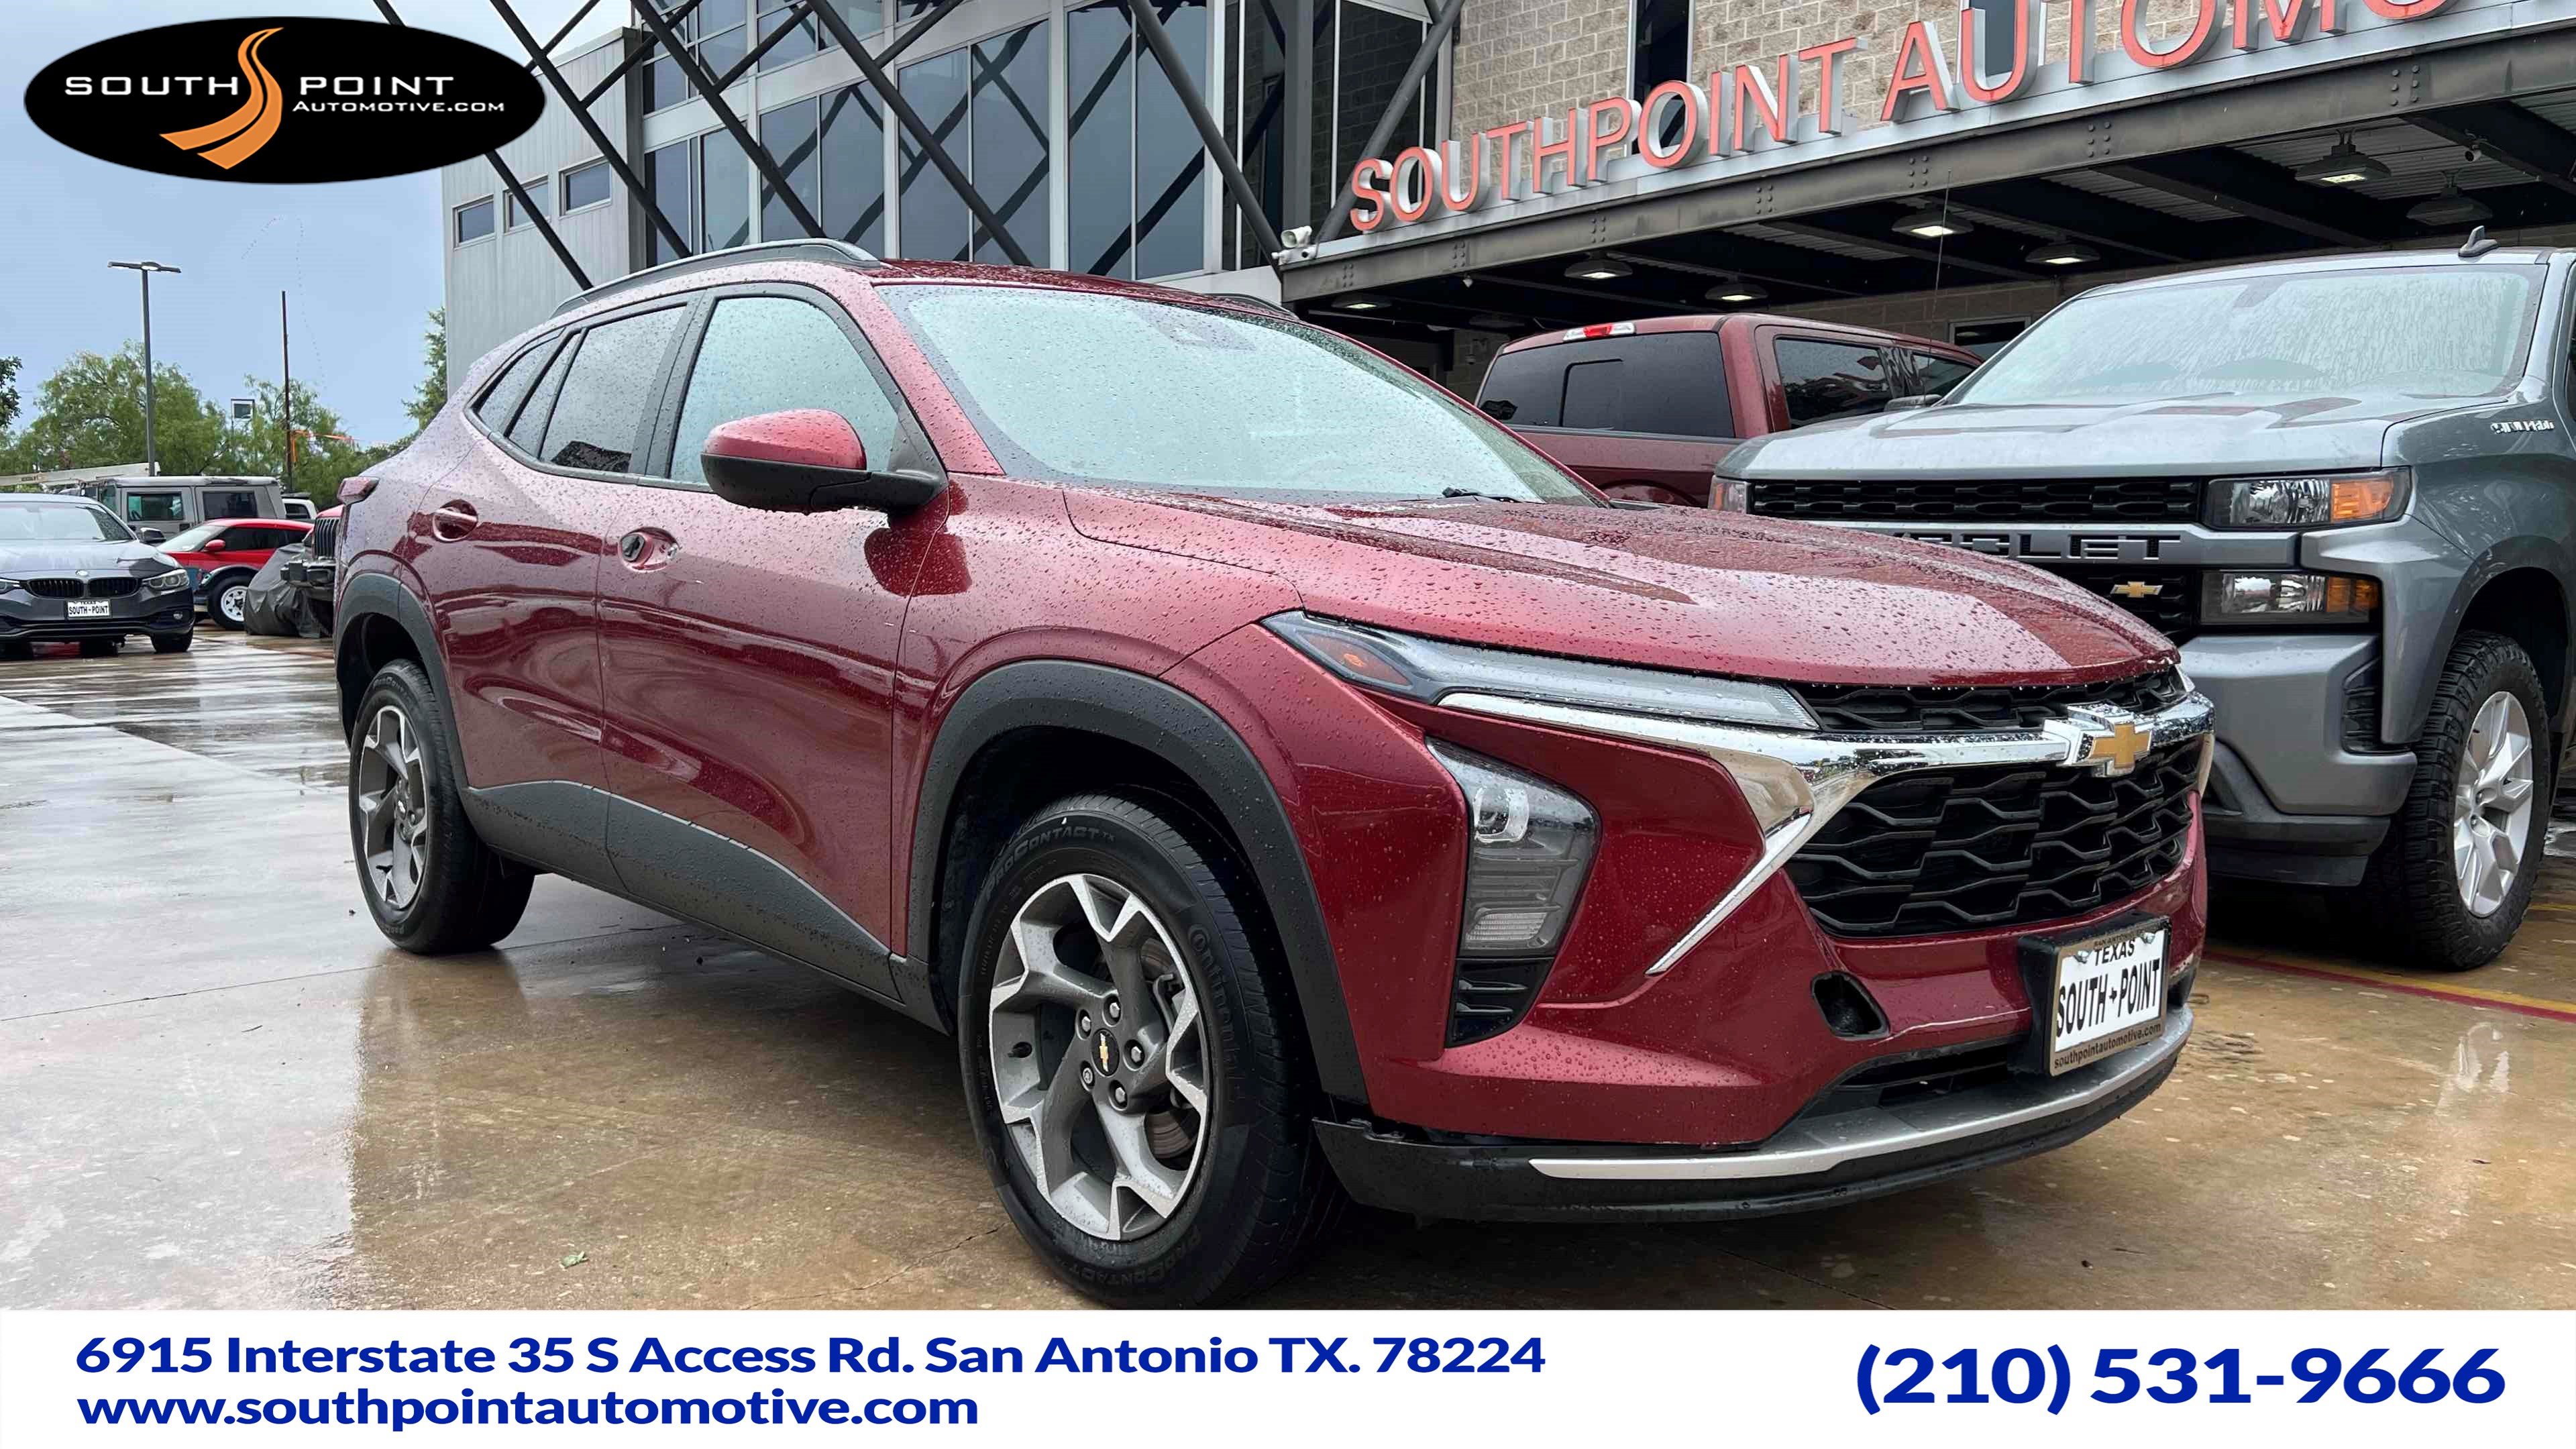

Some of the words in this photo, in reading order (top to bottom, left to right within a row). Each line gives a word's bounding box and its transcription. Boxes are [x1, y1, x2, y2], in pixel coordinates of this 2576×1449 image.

[1350, 37, 1865, 232] SOUTHPOINT
[69, 606, 87, 614] SOUTH
[92, 606, 107, 614] POINT
[2094, 939, 2136, 966] TEXAS
[2057, 973, 2108, 1038] SOUTH
[2118, 958, 2160, 1018] POINT
[2054, 1022, 2161, 1069] southpointautomotive.com
